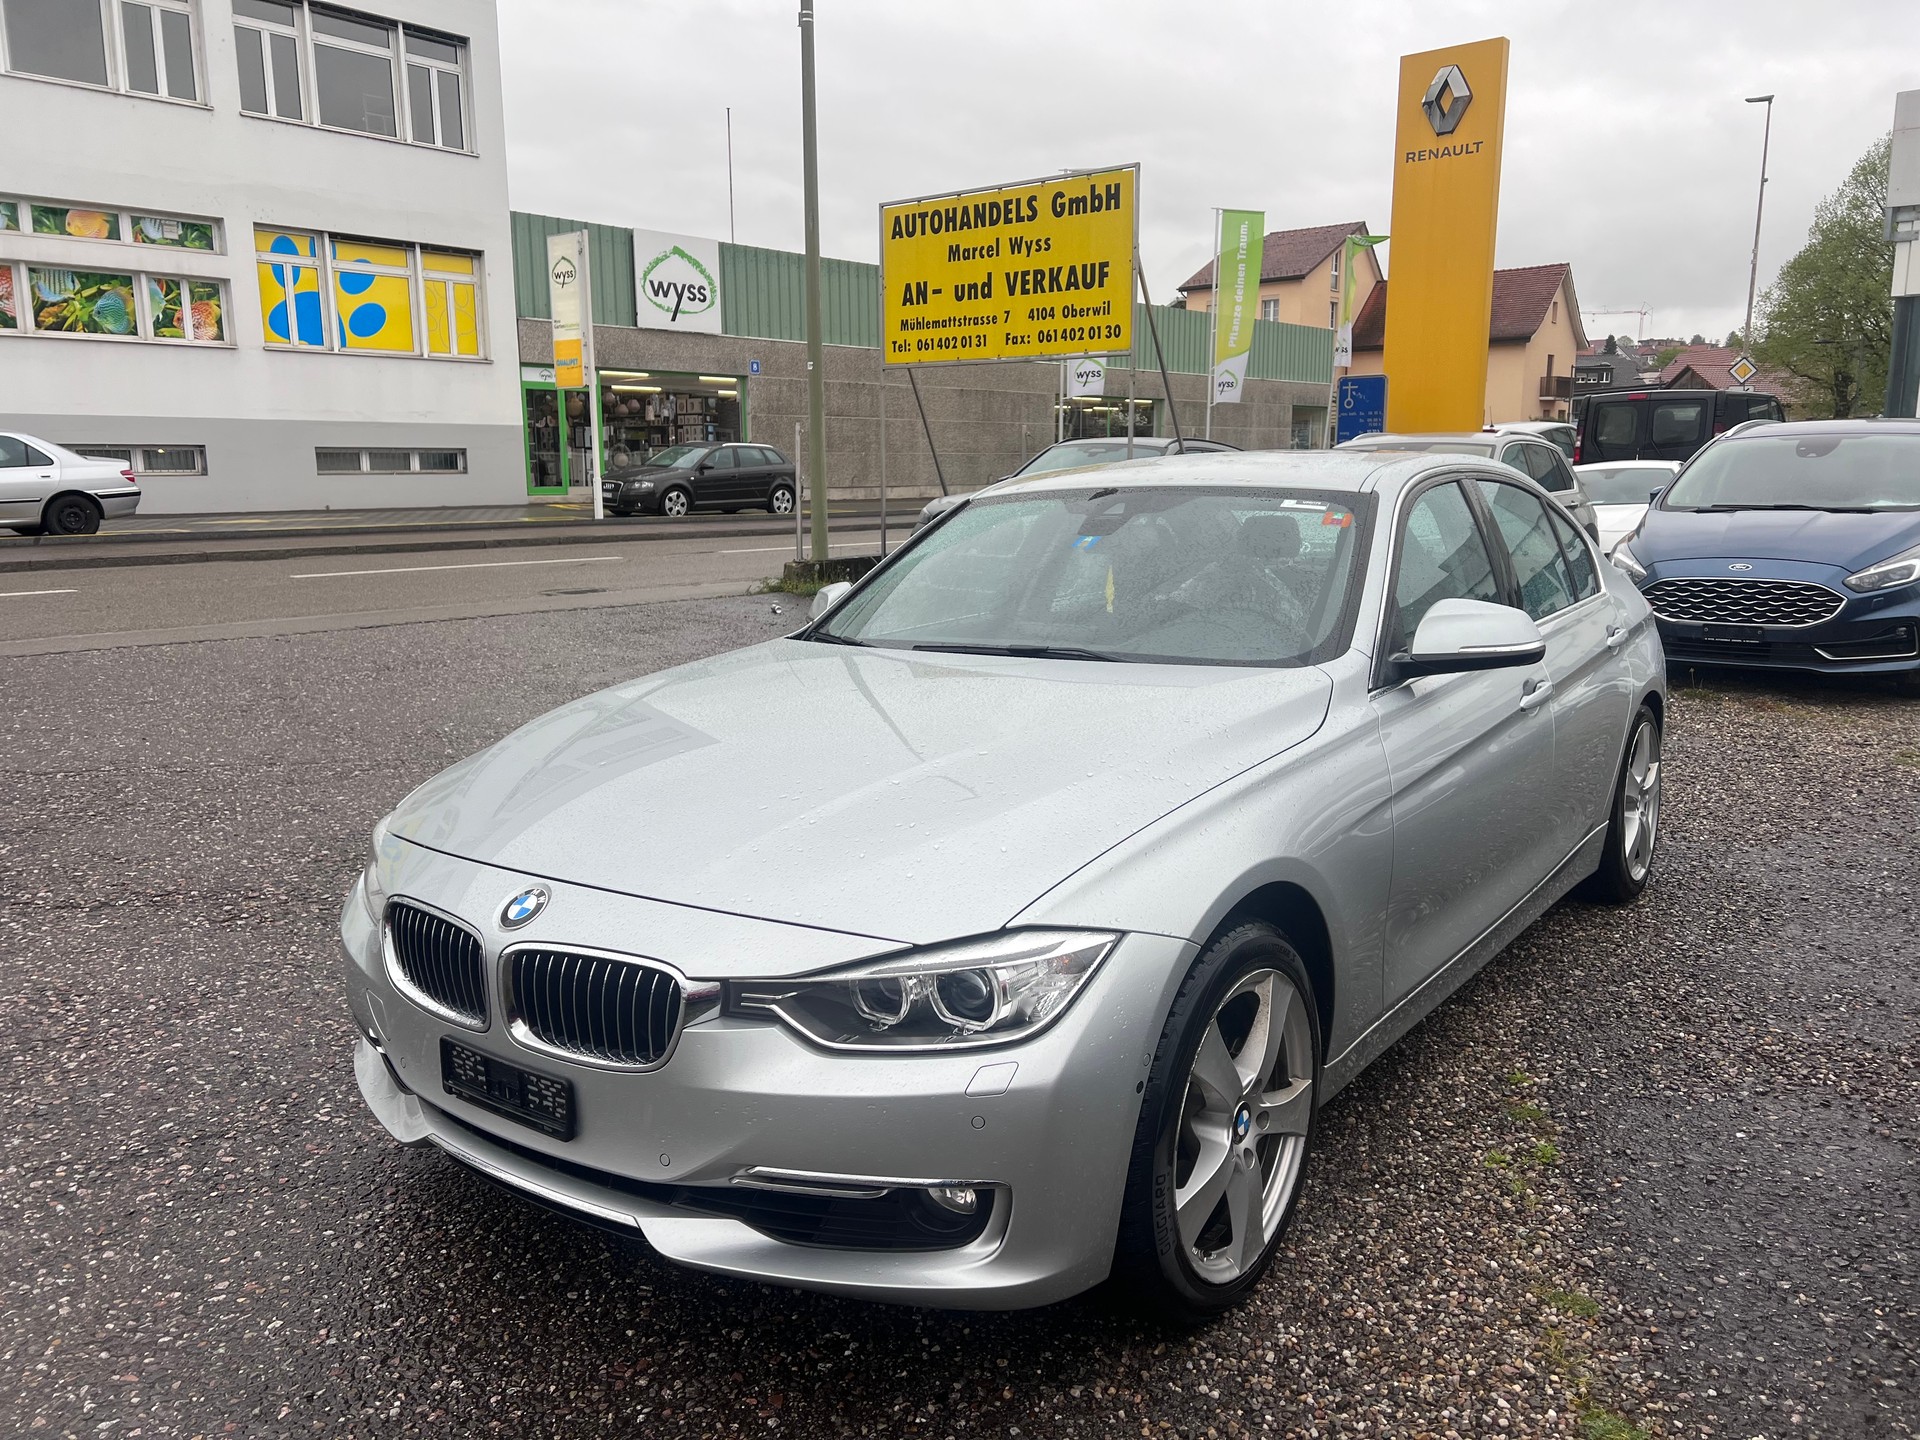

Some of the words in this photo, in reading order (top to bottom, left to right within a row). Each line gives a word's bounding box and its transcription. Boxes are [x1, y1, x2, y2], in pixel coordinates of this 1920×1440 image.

[1406, 141, 1483, 163] RENAULT
[891, 195, 1038, 240] AUTOHANDELS
[1051, 183, 1121, 218] GmbH
[947, 238, 1000, 263] Marcel
[1009, 235, 1051, 257] Wyss
[1237, 221, 1248, 260] Traum.
[554, 270, 574, 288] wyss
[954, 272, 992, 302] und
[1004, 261, 1109, 297] VERKAUF
[1235, 263, 1246, 302] deinen
[648, 279, 707, 322] wyss
[900, 314, 998, 331] Mühlemattstrasse
[1003, 310, 1010, 323] 7
[1027, 306, 1056, 321] 4104
[1062, 300, 1111, 319] Oberwil
[892, 339, 911, 353] Tel:
[1005, 332, 1031, 345] Fax:
[752, 362, 758, 371] 8
[1077, 370, 1102, 387] wyss
[1156, 1173, 1171, 1256] GIUGIARO
